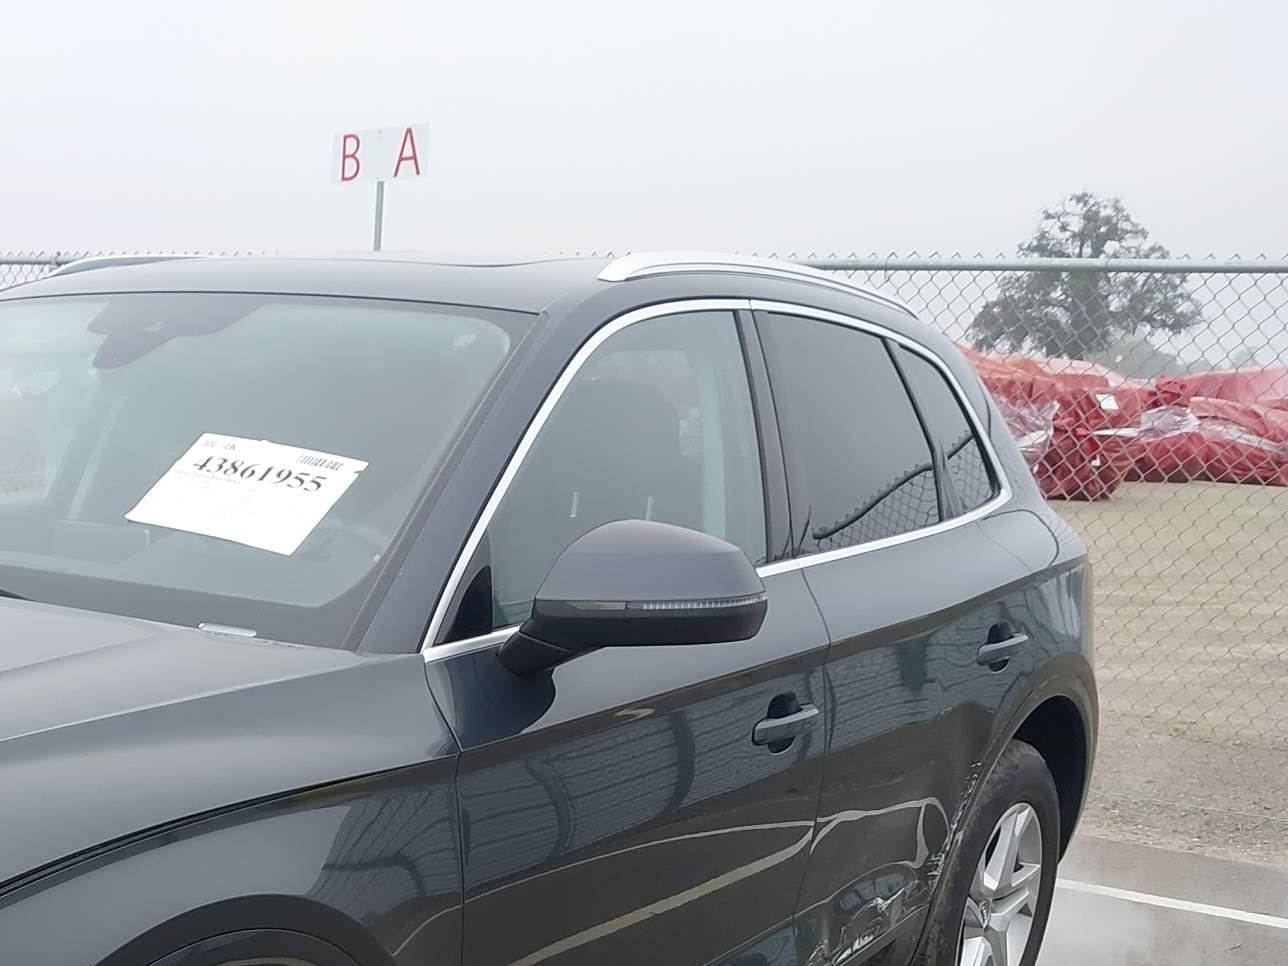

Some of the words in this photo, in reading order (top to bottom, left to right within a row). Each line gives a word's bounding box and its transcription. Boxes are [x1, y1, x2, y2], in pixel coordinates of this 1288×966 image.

[341, 134, 360, 181] B
[393, 127, 420, 178] A
[192, 455, 328, 493] 43861955
